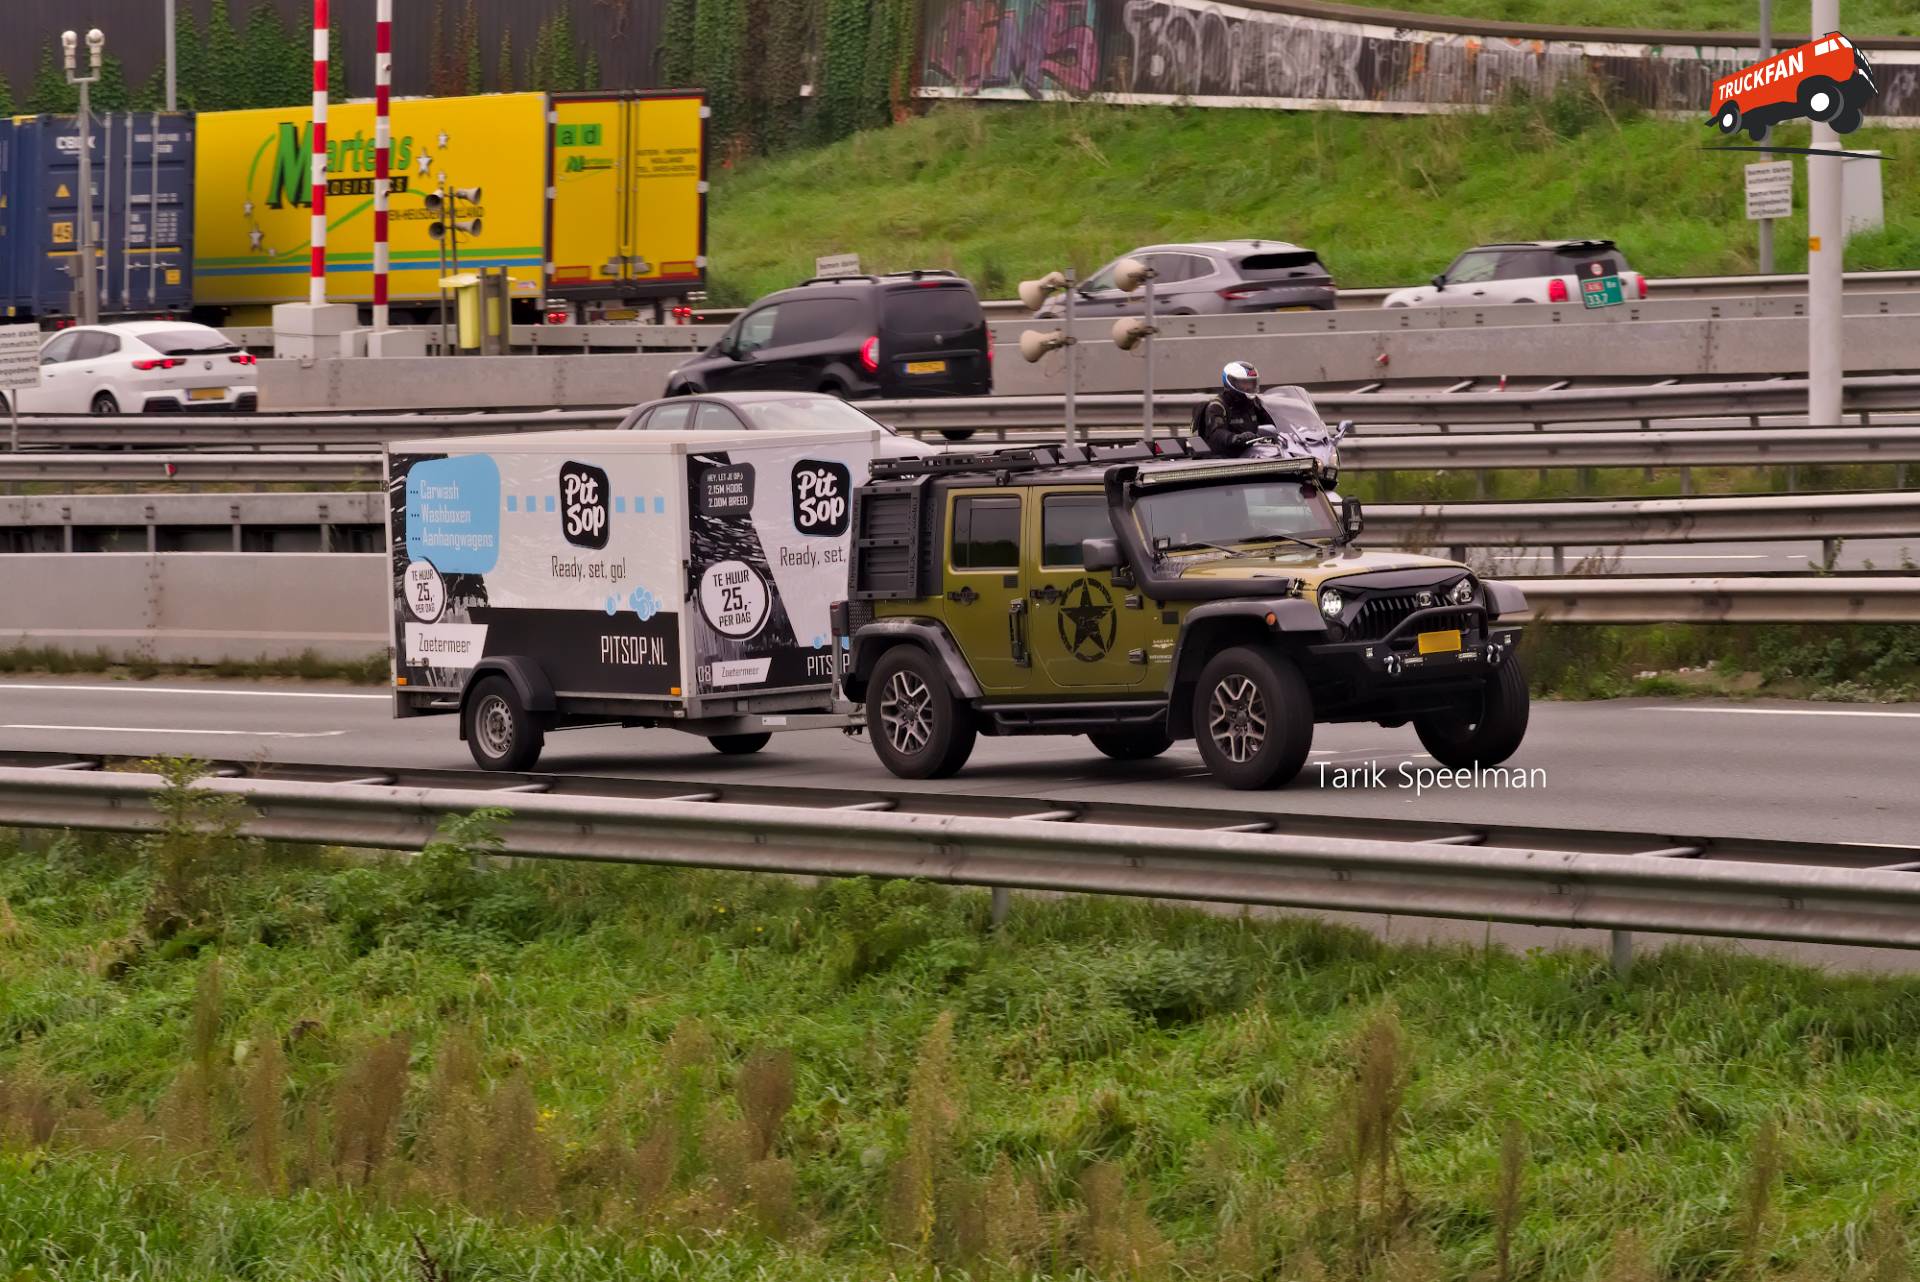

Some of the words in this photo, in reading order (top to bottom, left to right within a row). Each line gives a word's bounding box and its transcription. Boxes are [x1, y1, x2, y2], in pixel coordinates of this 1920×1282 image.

[326, 178, 405, 194] OGISS
[420, 480, 459, 499] Carwash
[563, 472, 599, 506] Pit
[796, 468, 838, 500] Pit
[728, 496, 748, 506] BREED
[800, 496, 845, 527] Sop
[421, 504, 471, 523] Washboxen
[567, 503, 606, 536] Sop
[422, 527, 493, 551] Aanhangwagens
[412, 570, 418, 581] TE
[610, 556, 626, 583] go!
[713, 573, 723, 587] TE
[725, 569, 750, 586] HUUR
[719, 614, 734, 628] PER
[736, 611, 752, 625] DAG
[418, 632, 471, 653] Zoetermeer
[601, 635, 668, 665] PITSOP.NL
[721, 666, 760, 678] Zoetermeer
[807, 653, 850, 677] PITSP
